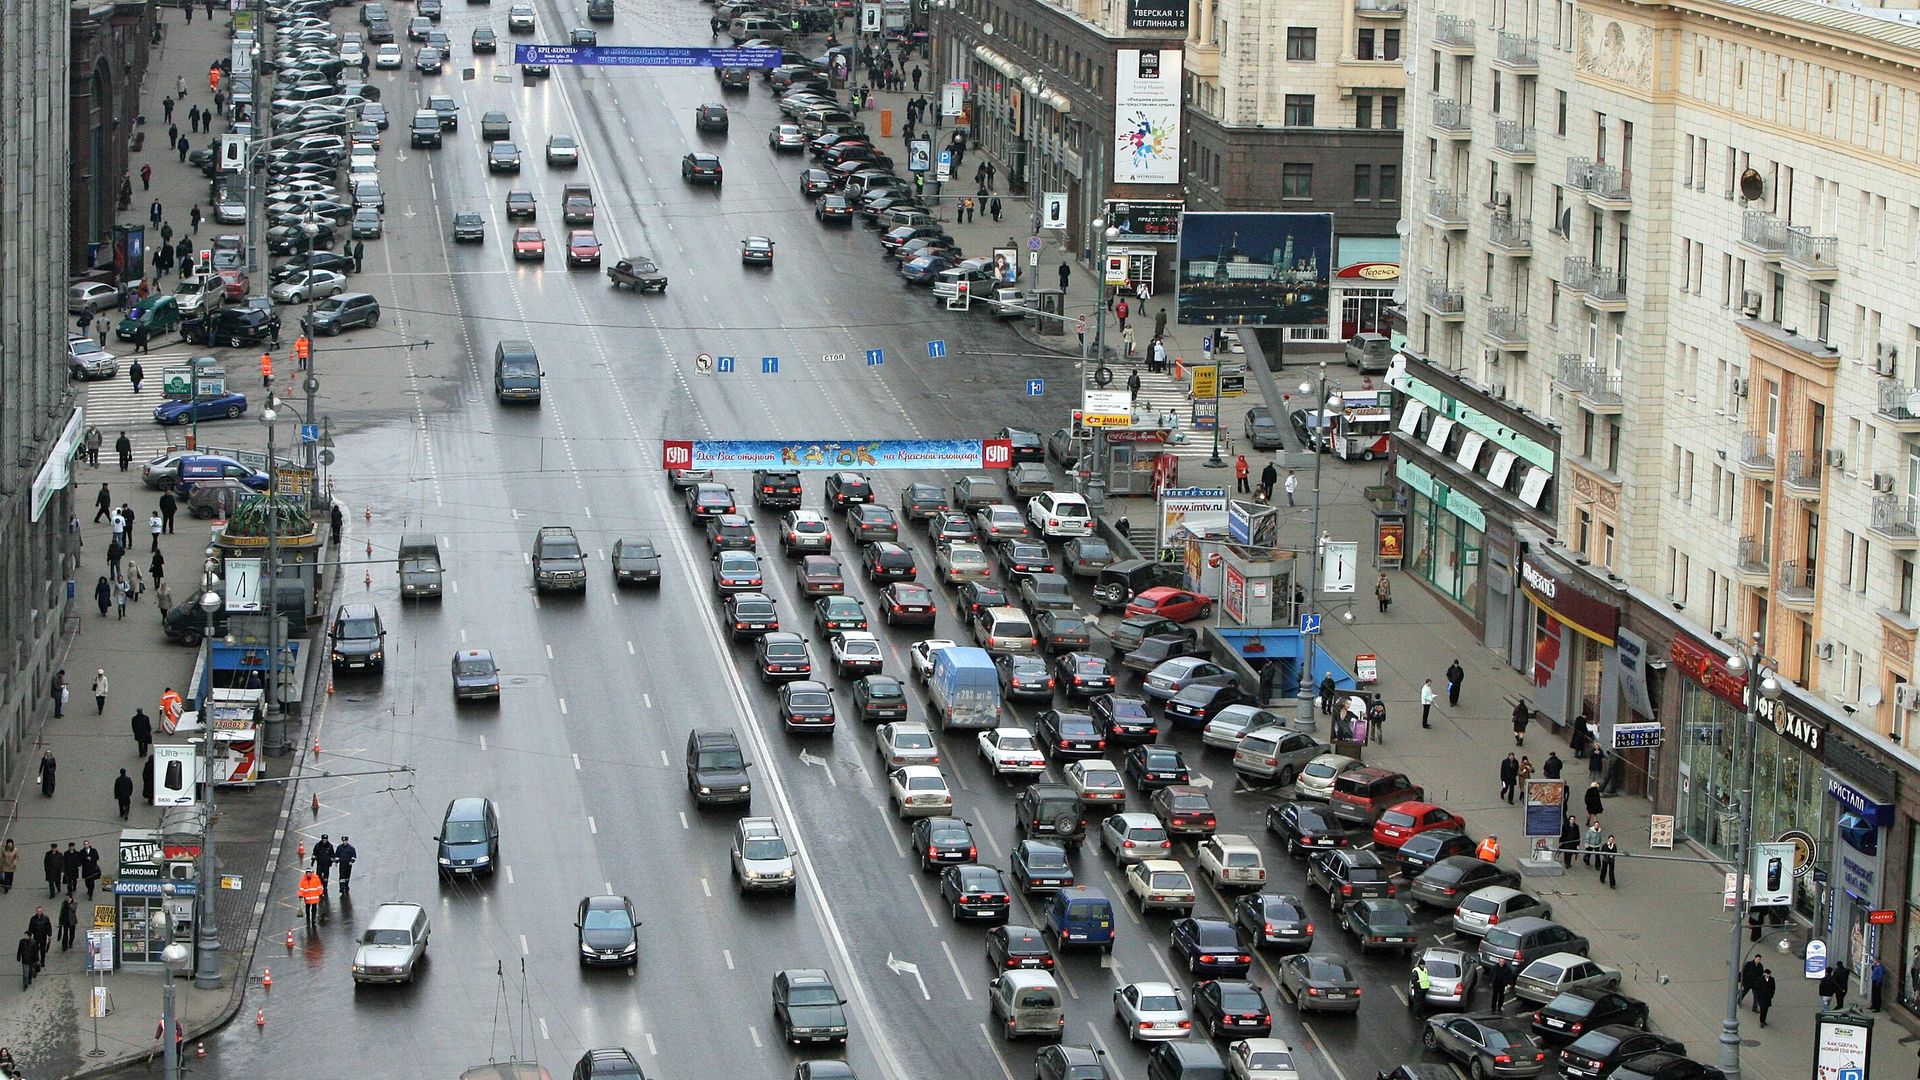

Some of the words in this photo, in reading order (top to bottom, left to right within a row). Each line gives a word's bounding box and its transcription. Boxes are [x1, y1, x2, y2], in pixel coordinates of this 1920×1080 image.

[941, 152, 948, 162] P
[1364, 268, 1396, 276] Теремок
[666, 447, 688, 463] ГУМ
[696, 451, 714, 461] Для
[718, 450, 735, 460] Вас
[737, 452, 775, 463] открыт
[898, 451, 936, 462] Красной
[938, 452, 978, 462] площади
[986, 445, 1008, 462] ГУМ
[1167, 502, 1222, 511] www.imtv.ru
[1786, 712, 1817, 749] ХАУЗ
[1828, 778, 1864, 811] КРИСТАЛЛ
[132, 844, 160, 857] БАНК
[121, 868, 159, 876] БАНКОМАТ
[116, 883, 177, 893] МОСГОРСПРА
